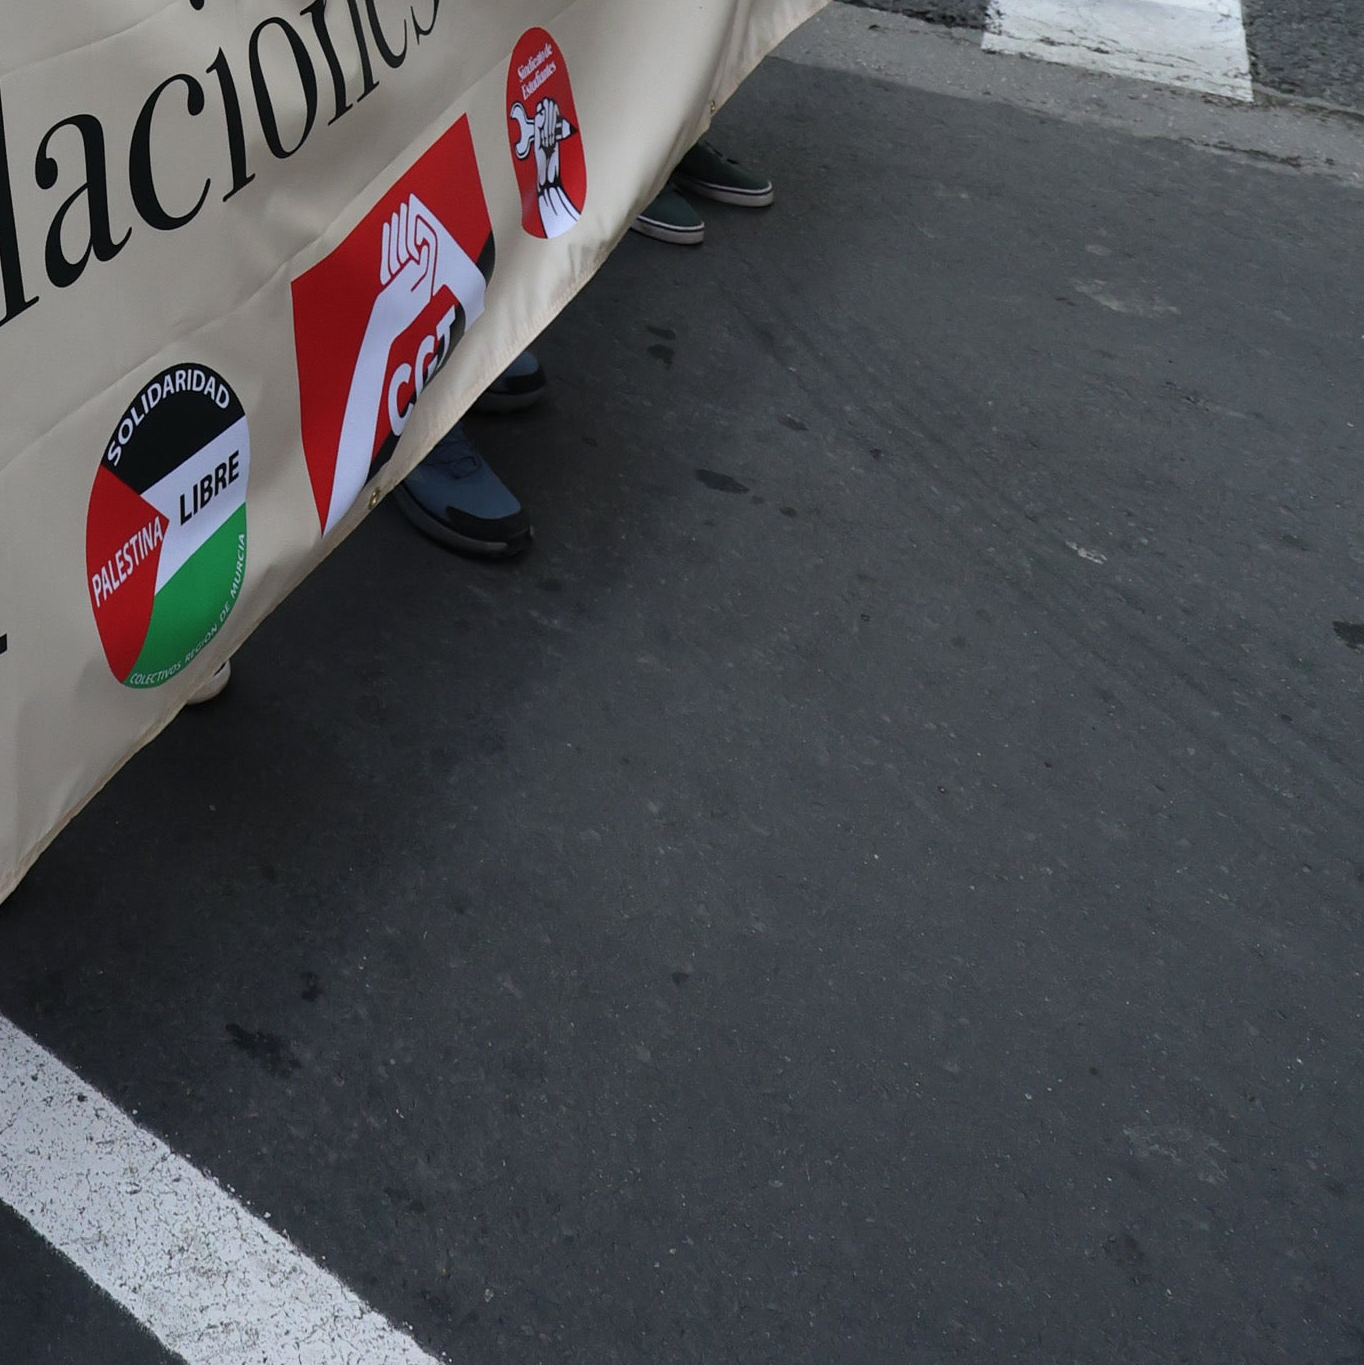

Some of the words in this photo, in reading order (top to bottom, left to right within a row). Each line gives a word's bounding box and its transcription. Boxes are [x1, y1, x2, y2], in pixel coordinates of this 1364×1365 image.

[107, 368, 230, 467] SOLIDARIDAD
[388, 304, 456, 437] CGT
[179, 450, 240, 526] LIBRE
[91, 516, 165, 607] PALESTINA
[130, 661, 182, 685] COLECTIVOS
[230, 533, 245, 598] MURCIA
